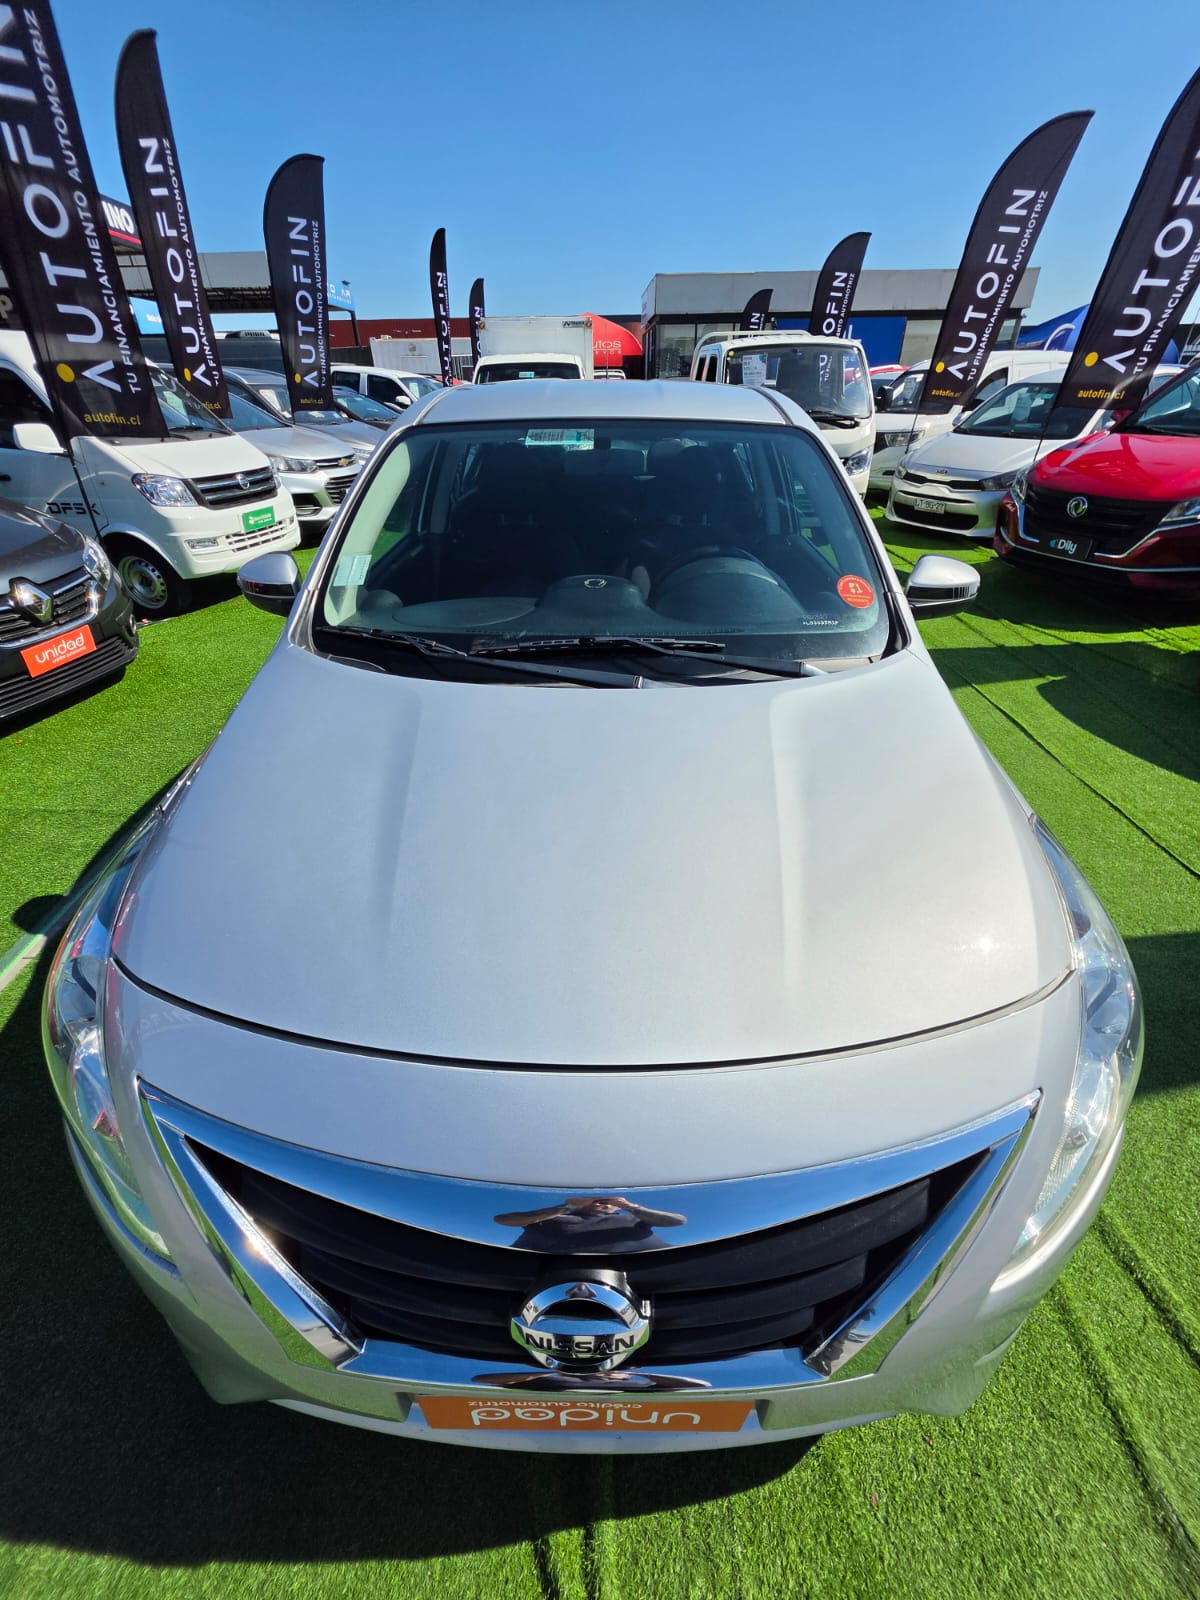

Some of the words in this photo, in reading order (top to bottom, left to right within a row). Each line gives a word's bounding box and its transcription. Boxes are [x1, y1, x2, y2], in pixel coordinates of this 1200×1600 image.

[23, 8, 84, 184] AUTOMOTRIZ
[162, 137, 190, 244] AUTOMOTRIZ
[138, 137, 212, 388] AUTOFIN
[312, 220, 323, 290] AUTOMOTRIZ
[73, 190, 136, 367] FINANCIAMIENTO
[947, 189, 1037, 380] AUTOFIN
[967, 367, 977, 381] TU
[973, 274, 1015, 366] FINANCIAMIENTO
[1012, 191, 1049, 271] AUTOMOTRIZ
[287, 216, 320, 388] AUTOFIN
[1132, 356, 1150, 377] TU
[125, 372, 143, 395] TU
[1077, 388, 1126, 400] autofin.cl
[84, 411, 141, 426] autofin.cl
[46, 502, 101, 516] DFSK
[34, 632, 85, 664] unidad
[524, 1332, 635, 1355] NISSAN
[466, 1400, 572, 1408] automotriz
[470, 1407, 701, 1427] unidad
